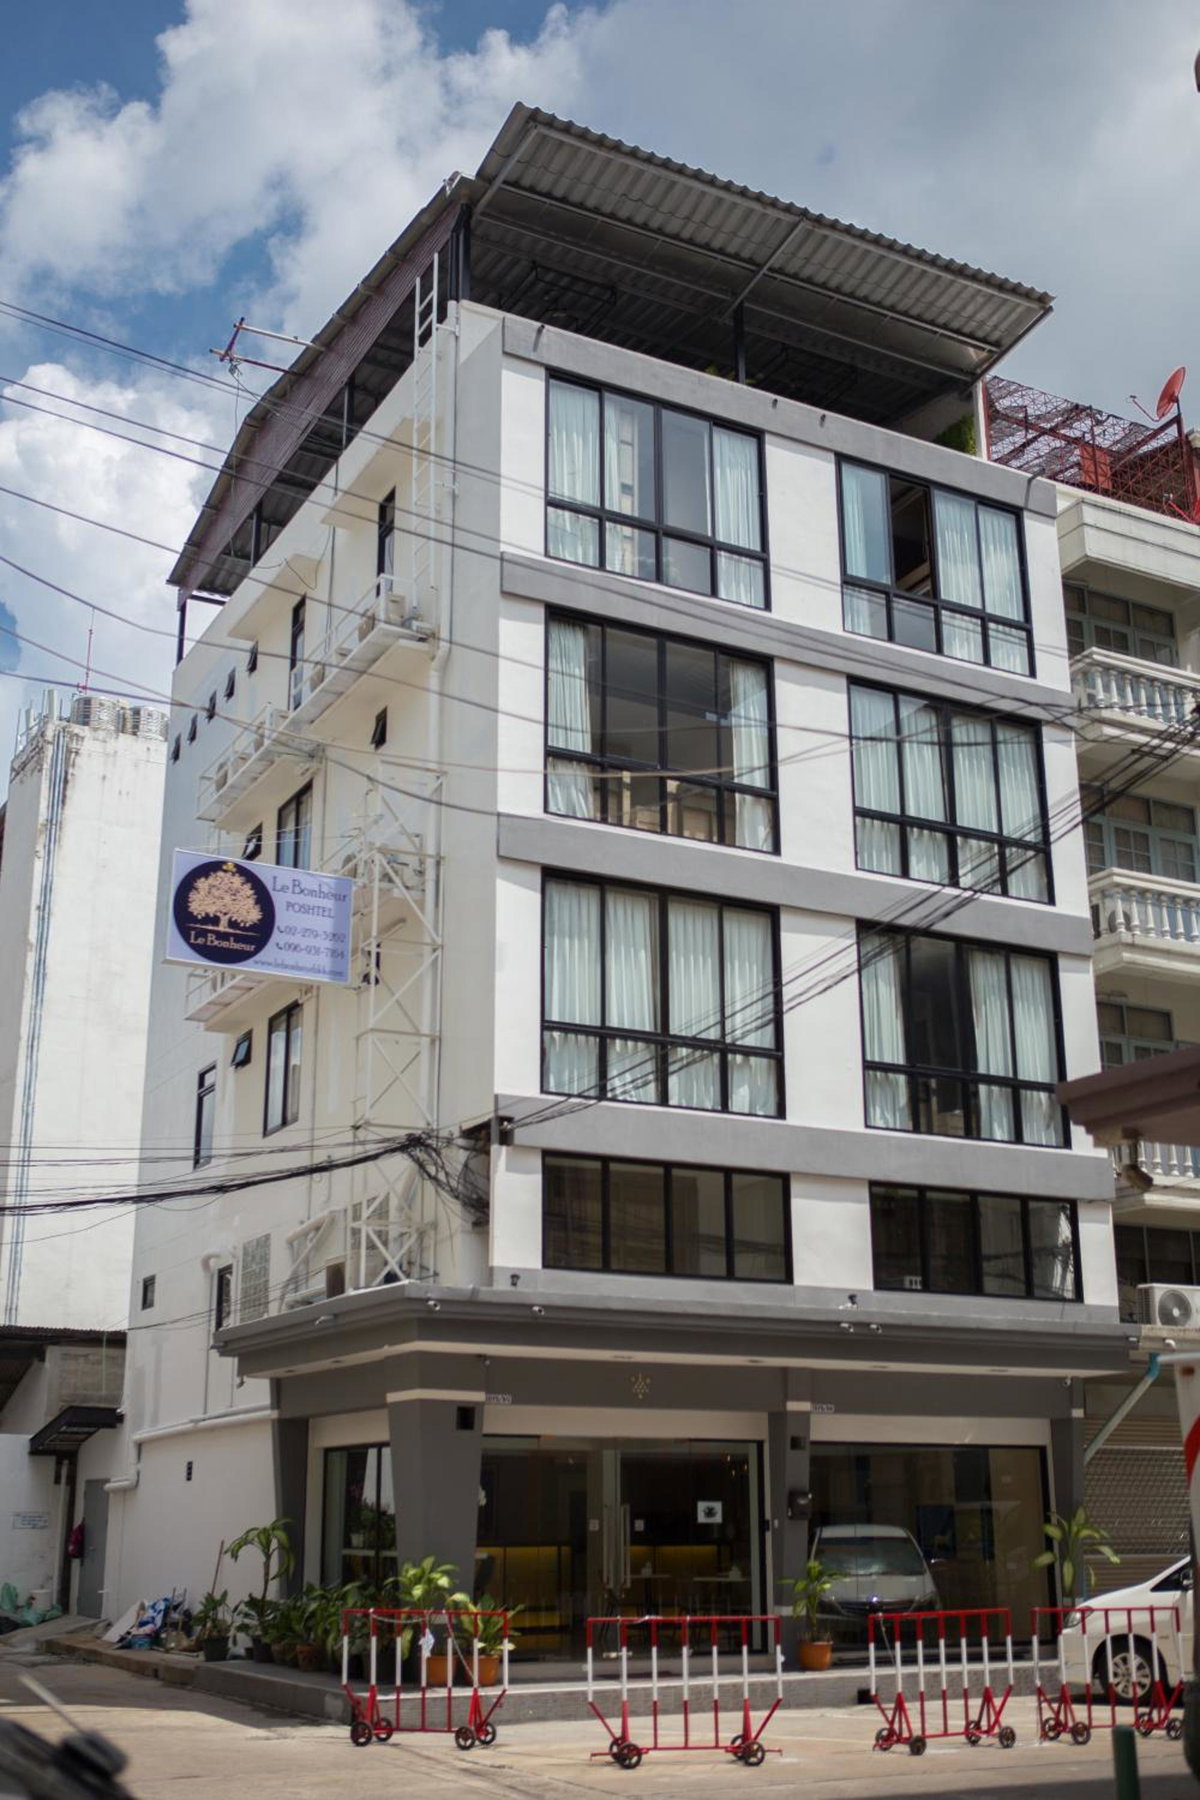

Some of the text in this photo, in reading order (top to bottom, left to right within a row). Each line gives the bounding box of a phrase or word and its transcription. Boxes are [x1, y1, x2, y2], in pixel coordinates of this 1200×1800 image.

[272, 876, 347, 902] Le Bonheur
[285, 901, 335, 919] POSHTEL
[189, 931, 256, 952] Le Bonheur
